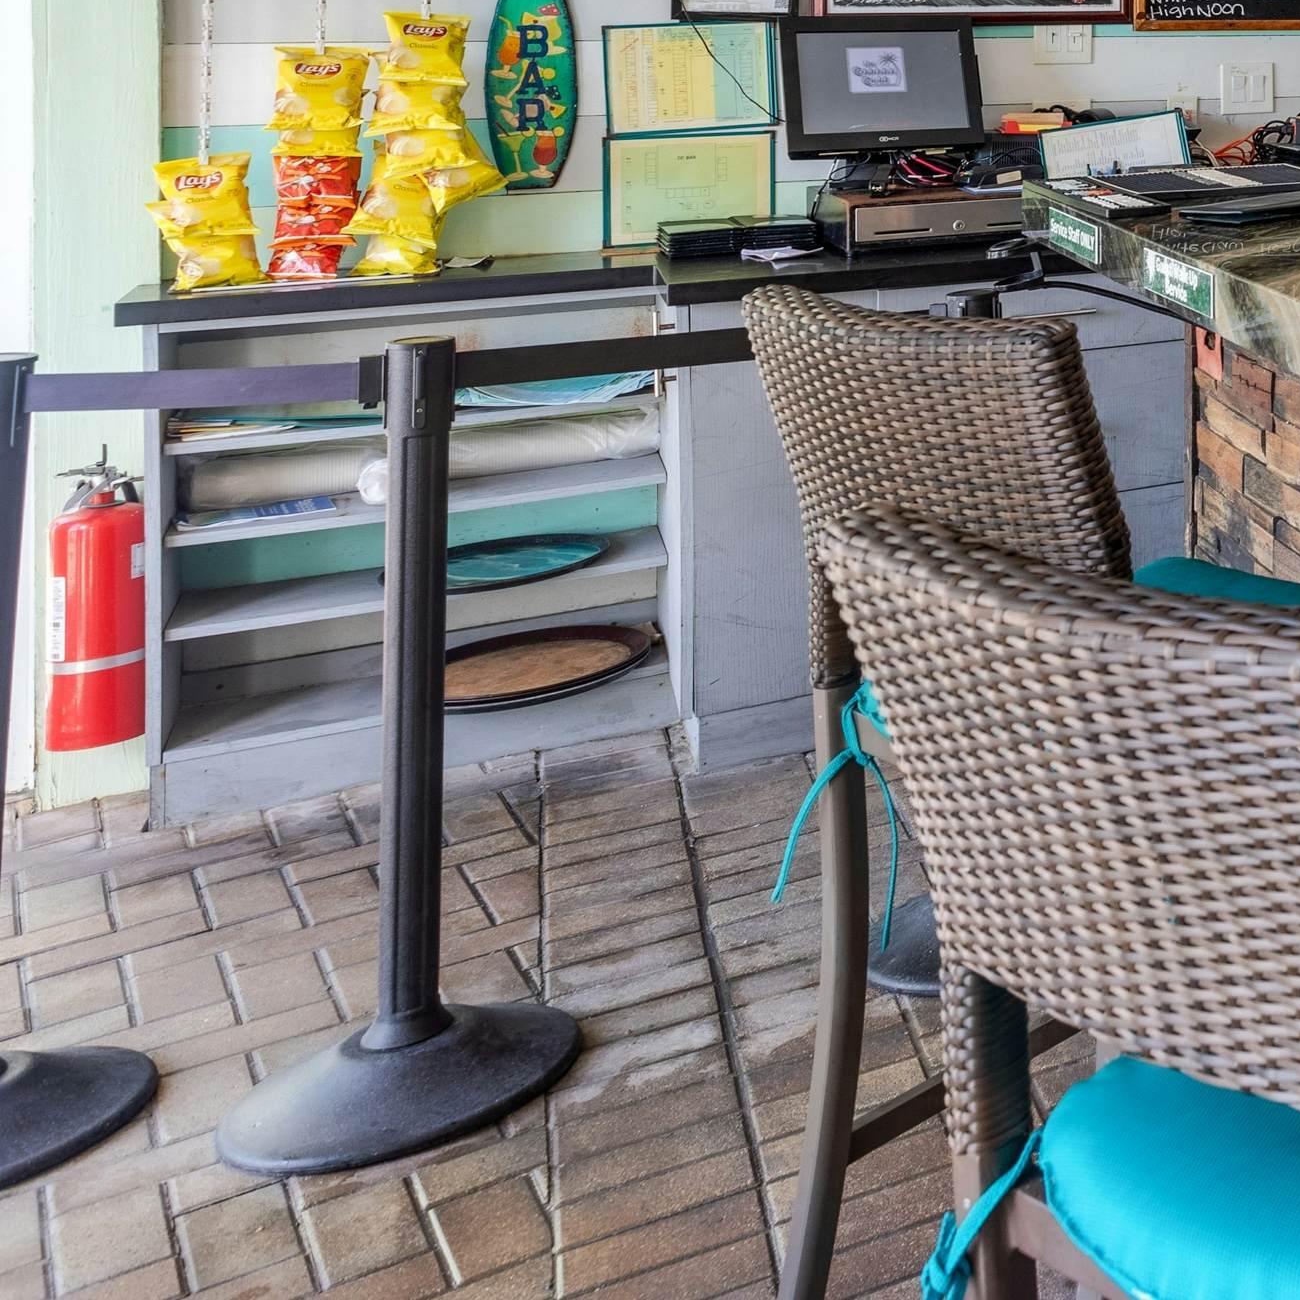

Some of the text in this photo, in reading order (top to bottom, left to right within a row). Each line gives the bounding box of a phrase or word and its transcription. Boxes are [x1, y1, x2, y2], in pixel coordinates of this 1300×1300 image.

[404, 23, 447, 38] Lay's
[295, 62, 341, 77] Lay's
[516, 24, 549, 132] BAR
[176, 171, 223, 189] Lay's
[1050, 218, 1095, 250] Service Staff ONLY
